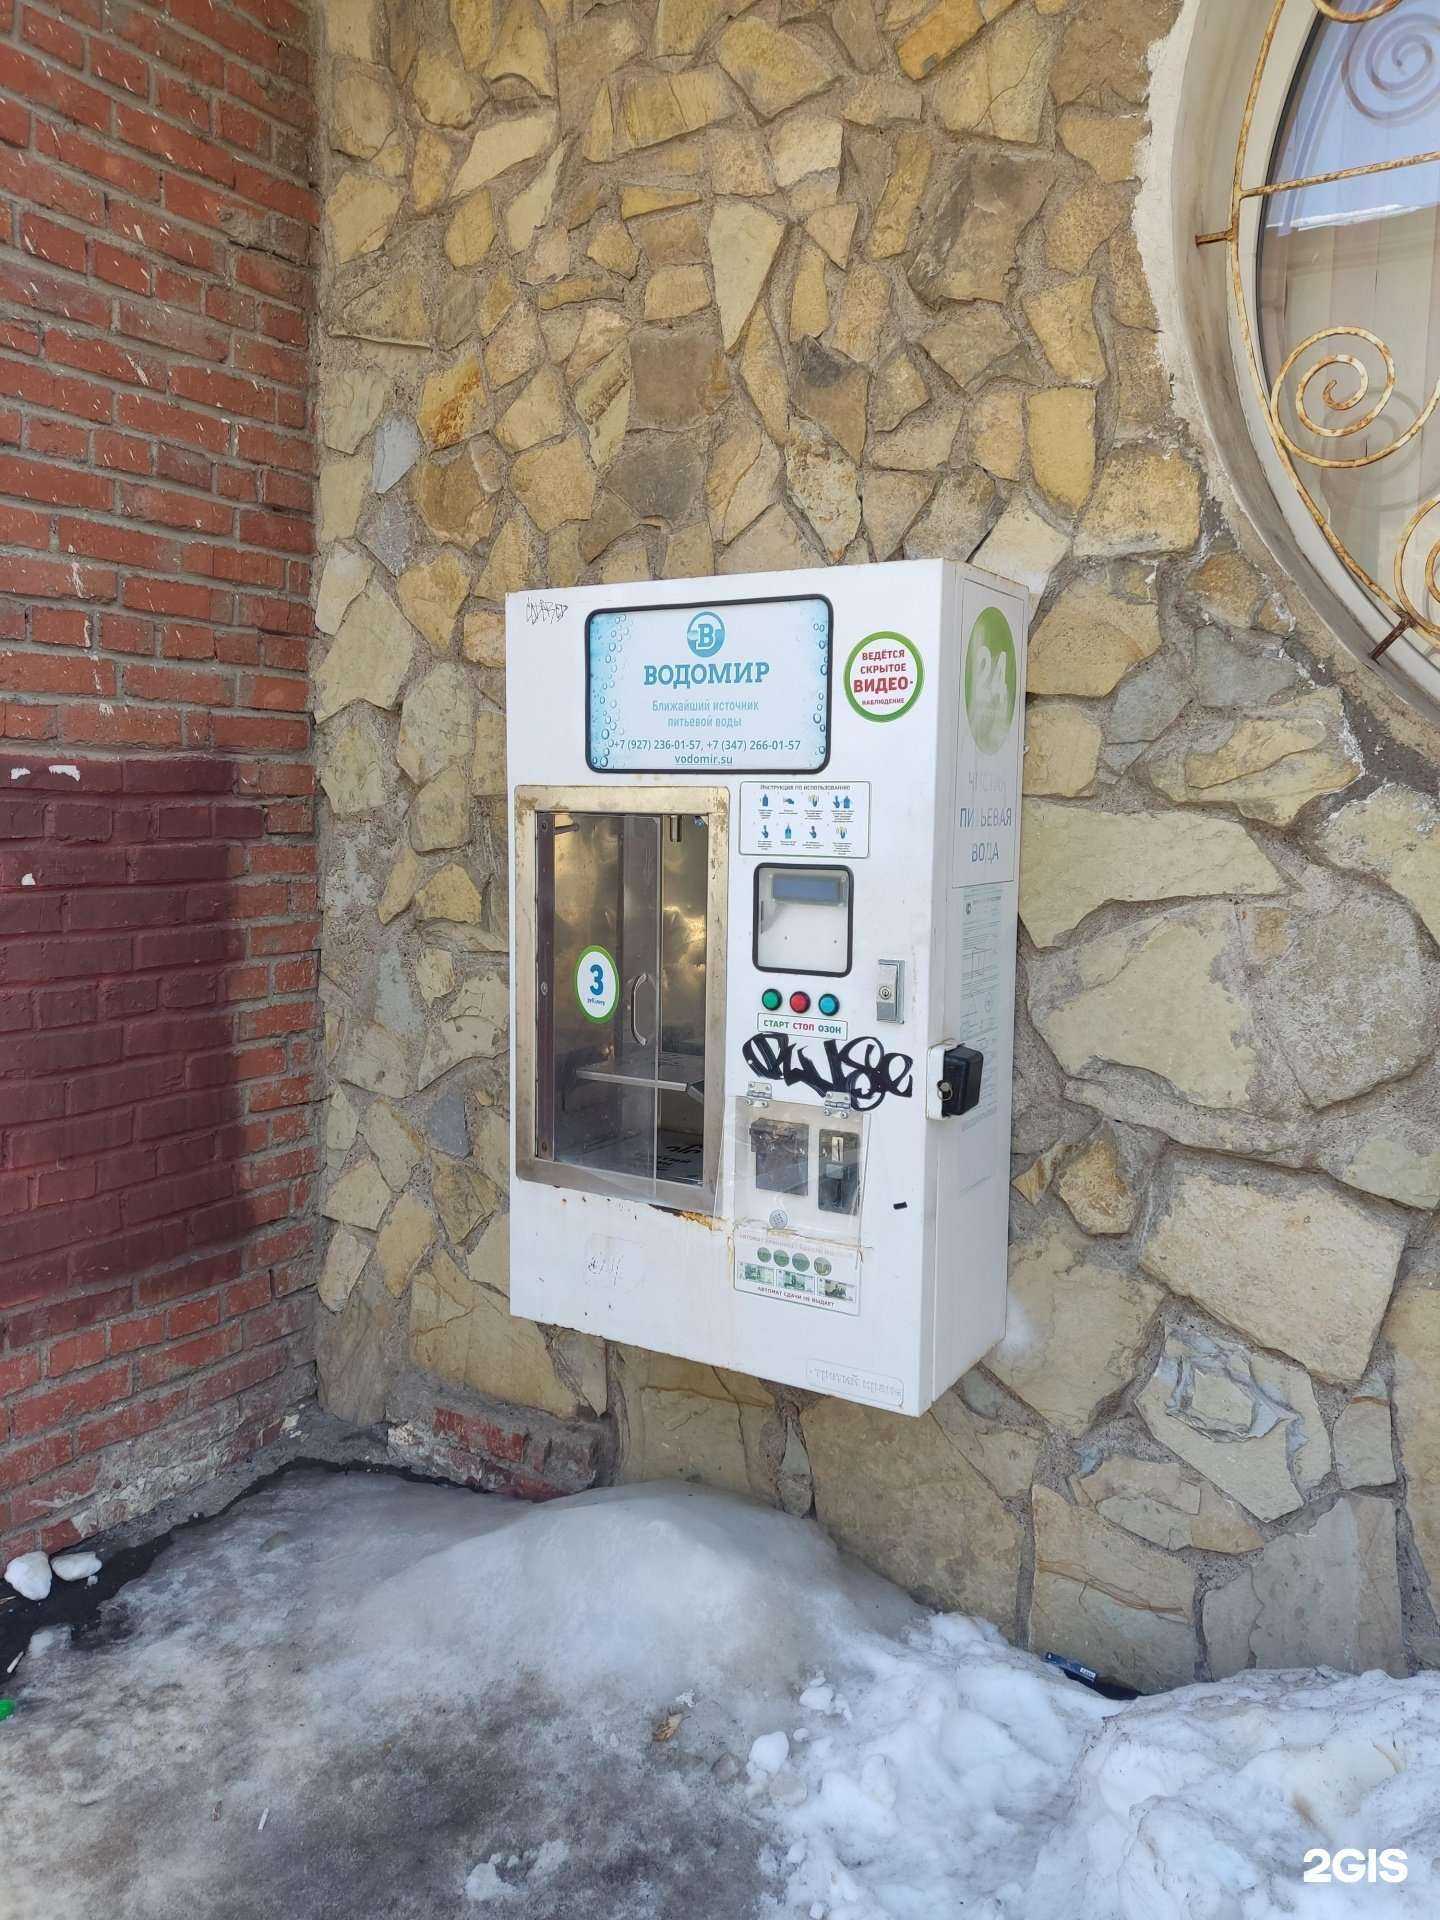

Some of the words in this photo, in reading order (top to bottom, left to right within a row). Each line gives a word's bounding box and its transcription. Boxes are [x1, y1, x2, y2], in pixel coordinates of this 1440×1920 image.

[862, 648, 905, 661] ВЕДЁТСЯ
[643, 661, 770, 689] ВОДОМИР
[860, 663, 906, 674] СКРЫТОЕ
[853, 676, 913, 694] ВИДЕО-
[652, 698, 711, 712] Ближайший
[713, 699, 759, 711] источник
[862, 697, 905, 705] НАБЛЮДЕНИЕ
[667, 715, 713, 728] питьевой
[715, 715, 742, 728] воды
[614, 740, 625, 750] +7
[627, 740, 651, 752] (927)
[653, 740, 704, 751] 236-01-57,
[706, 740, 718, 750] +7
[721, 740, 747, 752] (347)
[749, 739, 801, 751] 266-01-57
[675, 753, 733, 765] vodomir.su
[589, 964, 604, 996] 3
[763, 1019, 789, 1029] СТАРТ
[792, 1022, 815, 1032] СТОП
[818, 1025, 842, 1034] ОЗОН
[757, 1286, 783, 1296] АВТОМАТ
[783, 1292, 802, 1300] СДАЧИ
